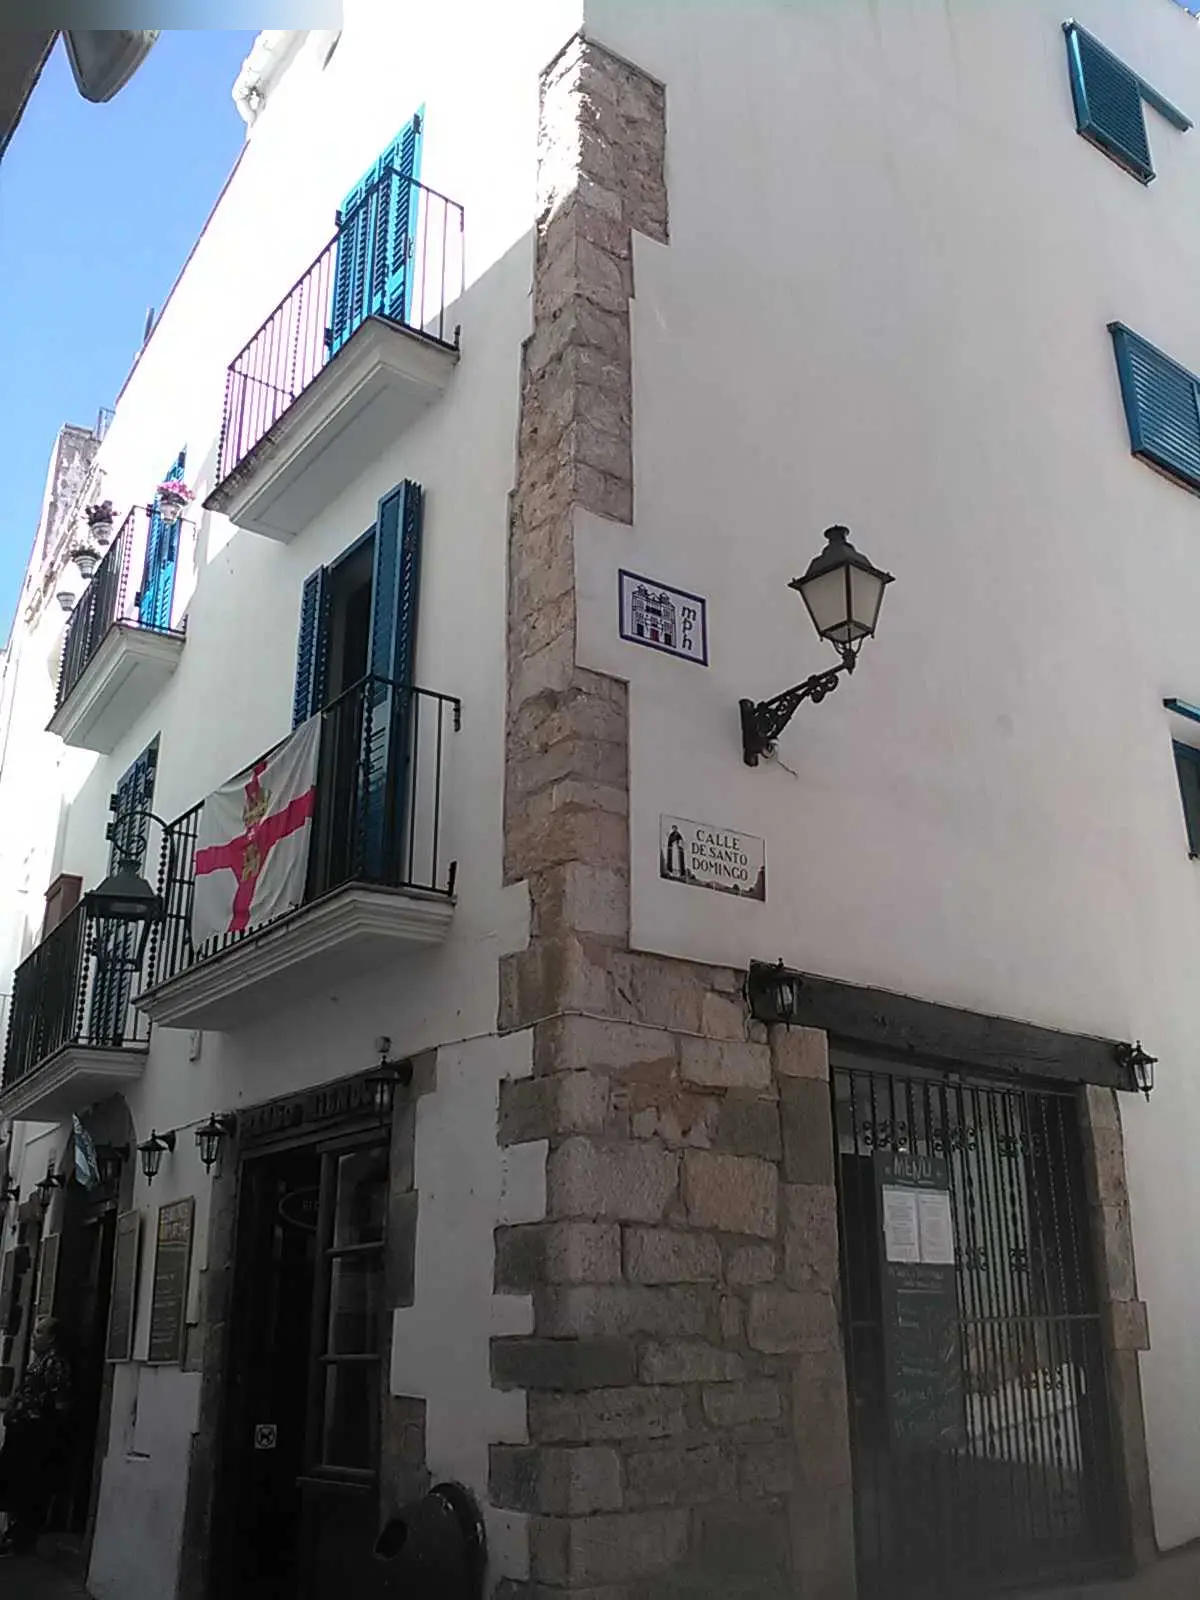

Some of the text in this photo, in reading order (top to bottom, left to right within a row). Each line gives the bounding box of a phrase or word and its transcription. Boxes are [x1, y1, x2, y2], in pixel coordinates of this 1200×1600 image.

[696, 829, 740, 851] CALLE
[691, 842, 748, 866] DE SANTO
[692, 857, 748, 881] DOMINGO
